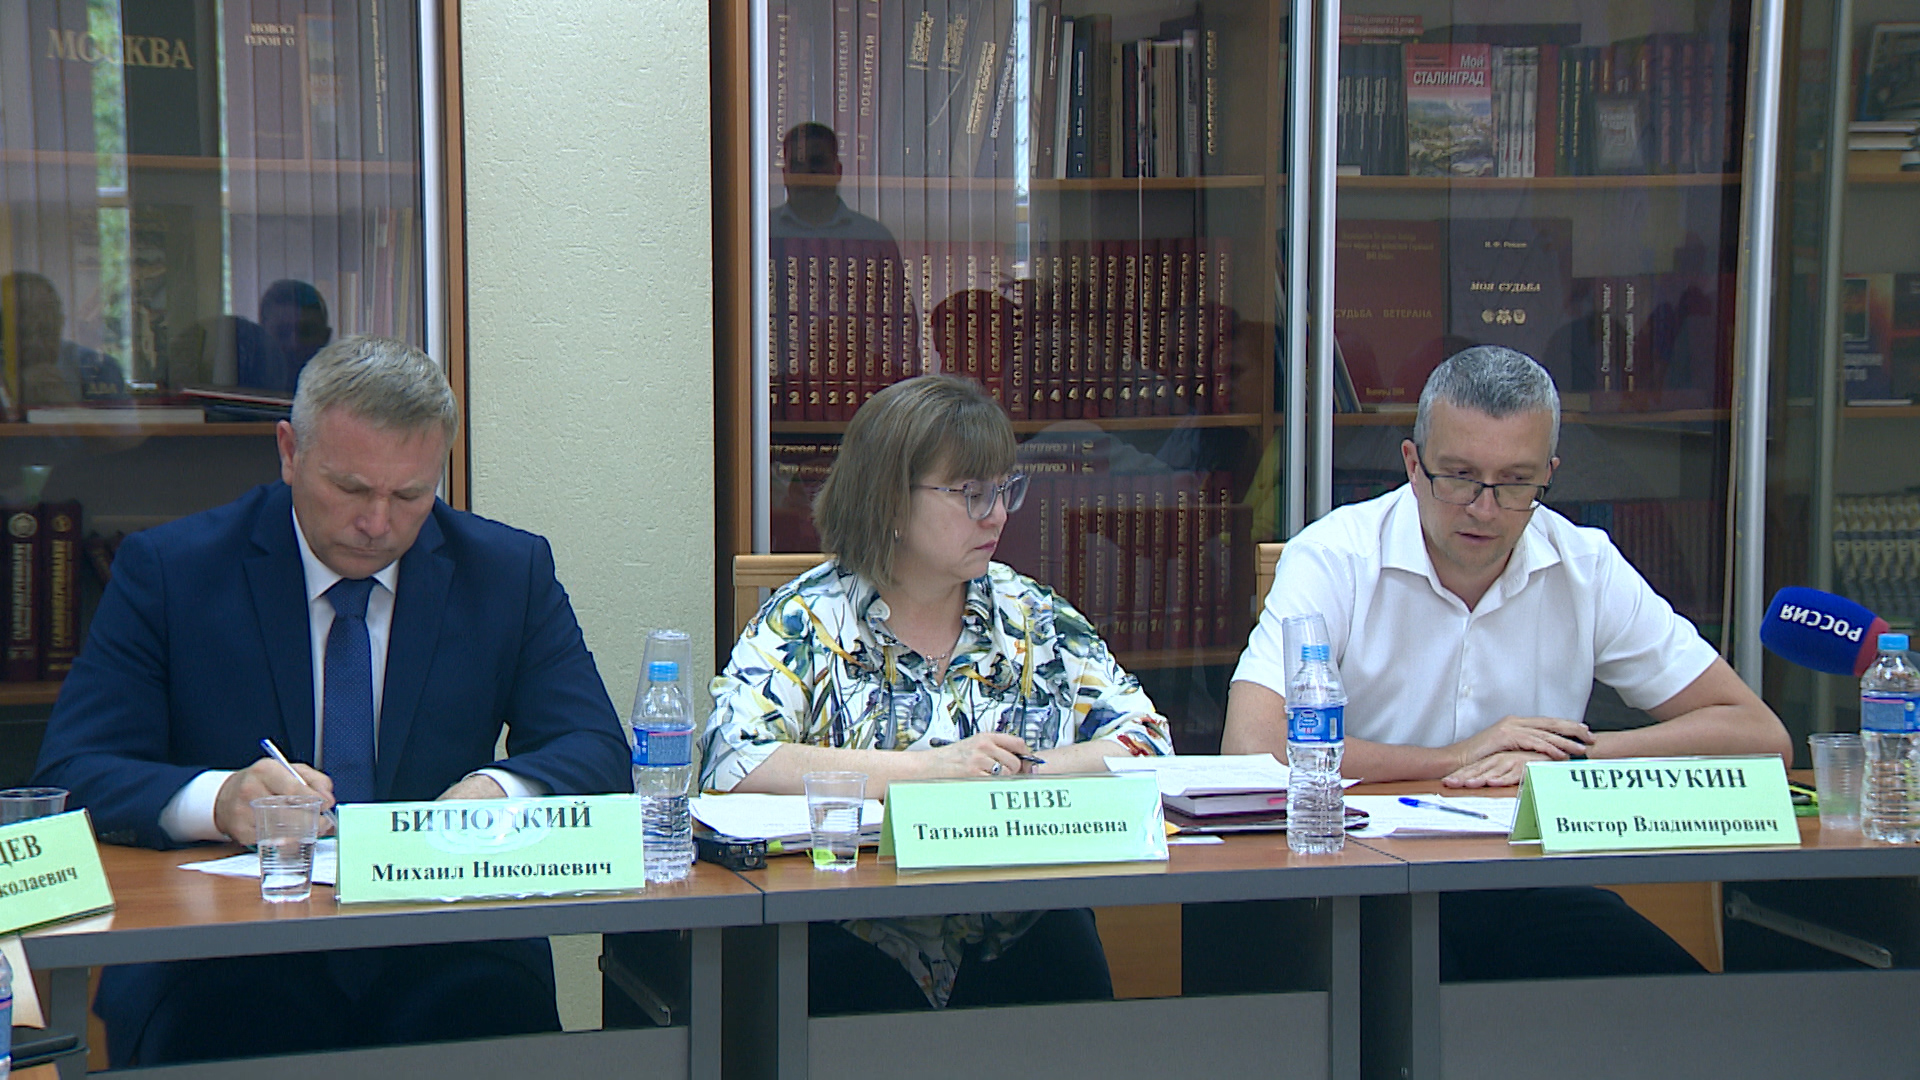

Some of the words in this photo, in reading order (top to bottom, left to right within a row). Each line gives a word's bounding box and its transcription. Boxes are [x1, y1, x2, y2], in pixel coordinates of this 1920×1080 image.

[838, 31, 849, 112] ПОБЕДИТЕЛИ
[1460, 53, 1485, 68] Мой
[860, 34, 876, 117] ПОБЕДИТЕЛИ
[1413, 71, 1485, 87] СТАЛИНГРАД
[1470, 281, 1495, 292] МОЯ
[1498, 282, 1541, 293] СУДЬБА
[1383, 309, 1433, 319] ВЕТЕРАНА
[1779, 603, 1863, 642] РОССИЯ
[1569, 768, 1748, 790] ЧЕРЯЧУКИН
[990, 789, 1072, 811] ГЕНЗЕ
[390, 800, 593, 833] БИТЮЦКИЙ
[1556, 817, 1628, 837] Виктор
[1634, 816, 1778, 836] Владимирович
[913, 822, 999, 841] Татьяна
[1005, 819, 1128, 838] Николаевна
[371, 863, 465, 882] Михаил
[473, 860, 612, 879] Николаевич
